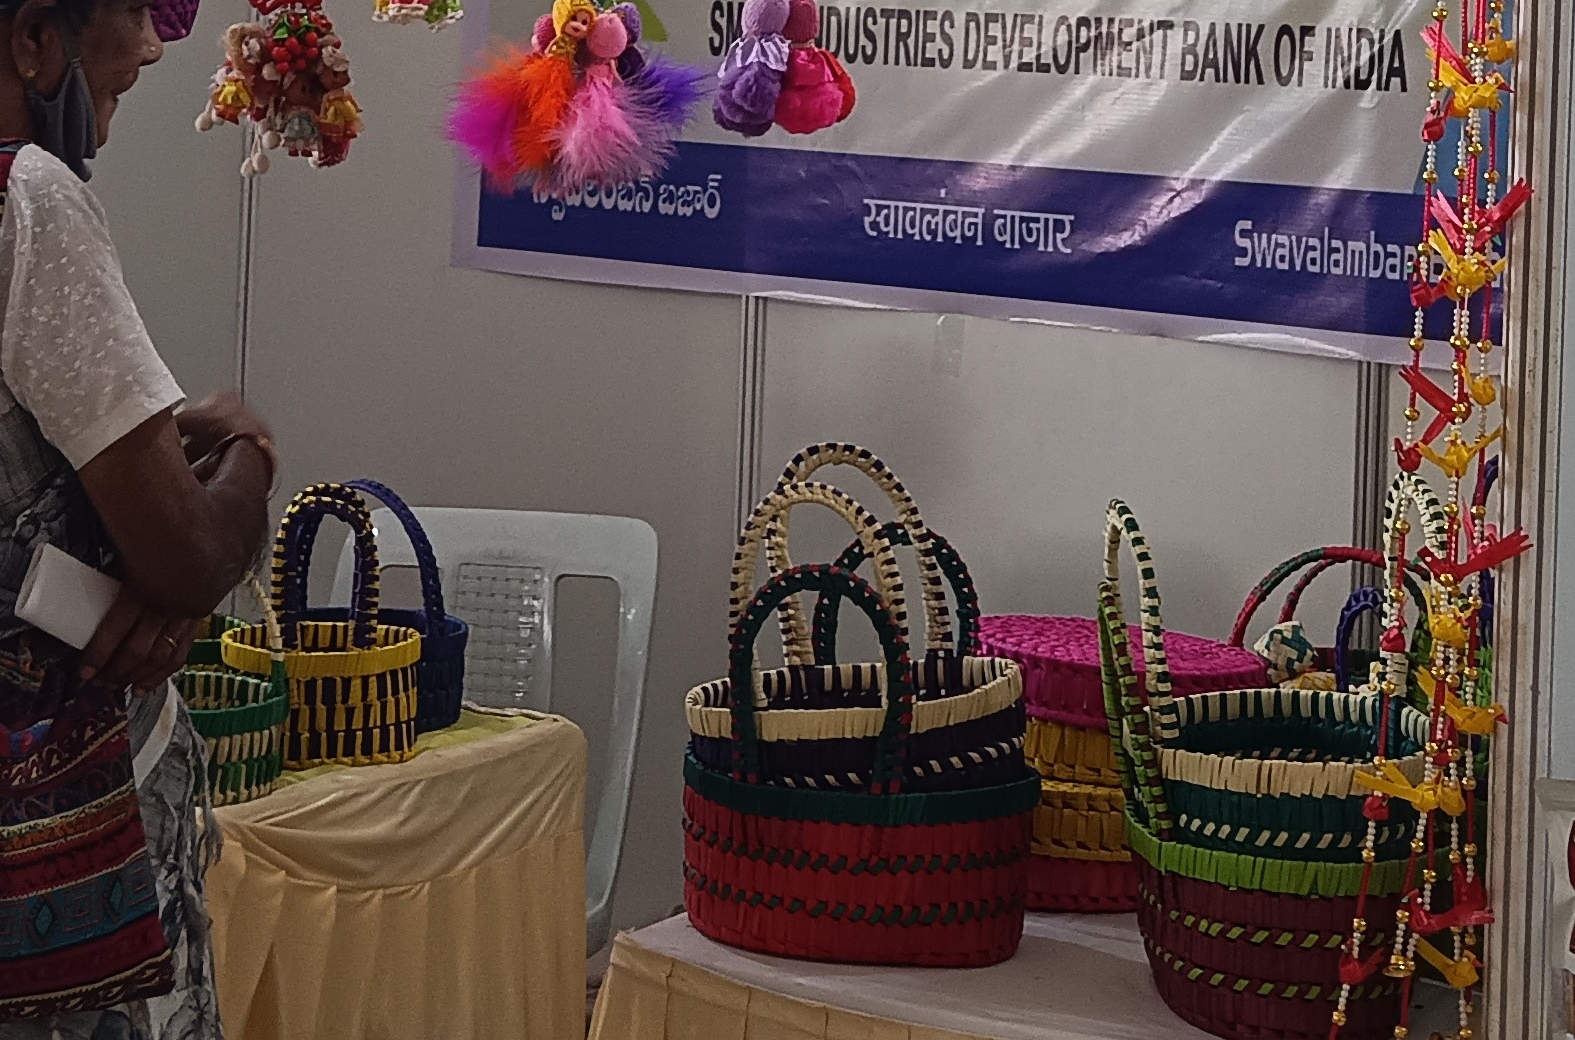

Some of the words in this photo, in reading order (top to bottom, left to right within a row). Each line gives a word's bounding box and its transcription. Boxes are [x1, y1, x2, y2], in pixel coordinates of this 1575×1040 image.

[962, 11, 1174, 80] DEVELOPMENT
[1179, 19, 1266, 86] BANK
[1274, 23, 1316, 88] OF
[1324, 26, 1409, 93] INDIA
[863, 188, 985, 246] स्वावलंबन
[993, 209, 1075, 254] बाजार
